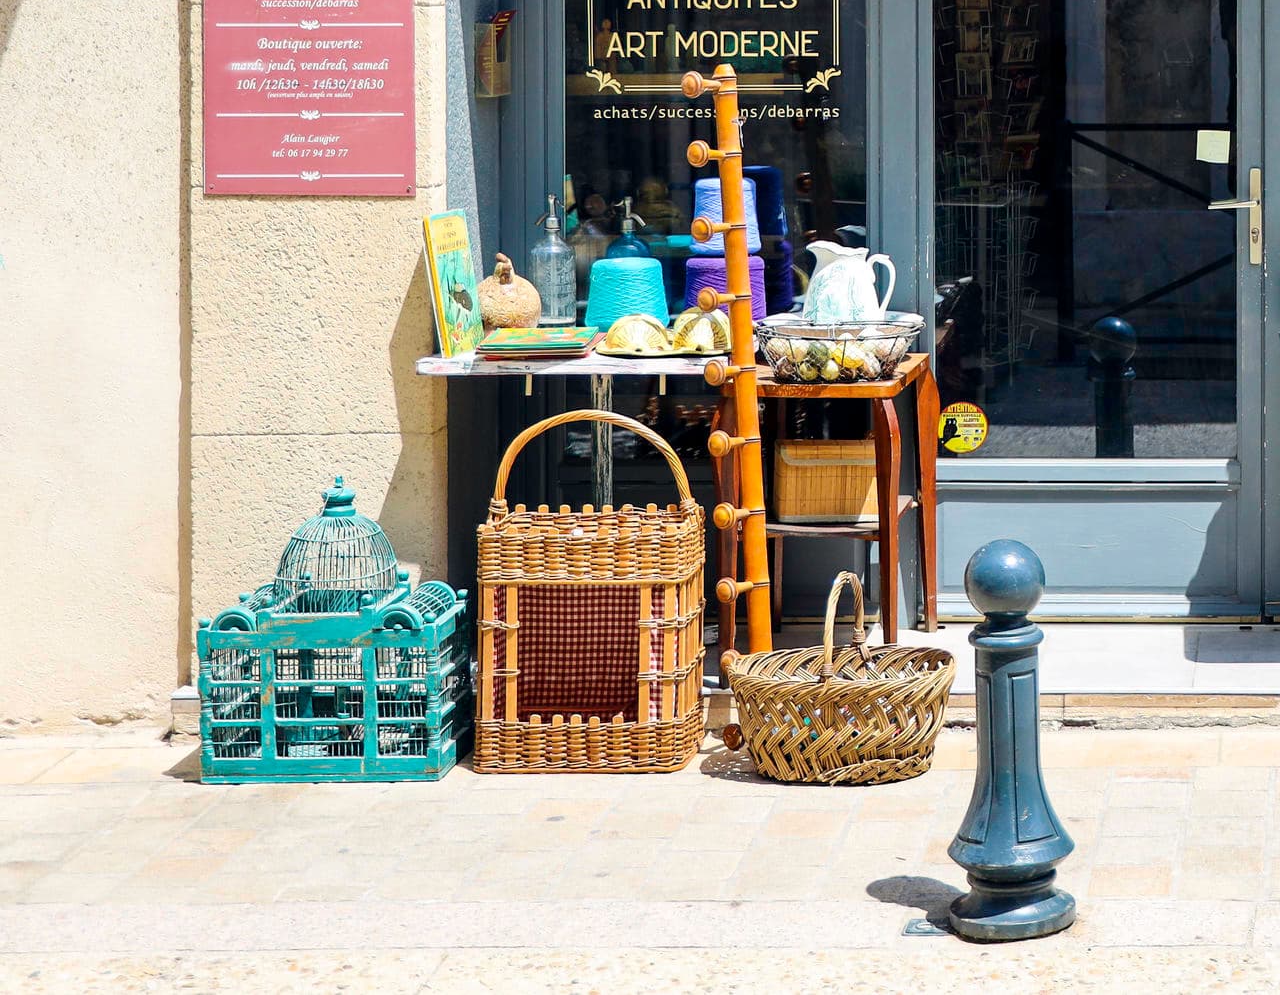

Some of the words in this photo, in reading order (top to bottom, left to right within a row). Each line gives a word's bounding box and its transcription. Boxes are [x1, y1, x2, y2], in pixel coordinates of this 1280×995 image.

[257, 37, 312, 52] Boutique
[315, 40, 363, 50] ouverte:
[606, 31, 664, 58] ART
[675, 30, 820, 58] MODERNE
[231, 59, 264, 72] mardi,
[265, 59, 297, 74] jeudi,
[301, 59, 349, 72] vendredi,
[352, 59, 389, 71] samedi
[236, 78, 256, 90] 10h
[593, 105, 840, 120] achats/succesns/debarras
[281, 134, 306, 144] Alain
[307, 134, 340, 145] Laugier
[287, 149, 299, 158] 06
[301, 149, 311, 158] 17
[312, 149, 323, 158] 94
[325, 149, 336, 158] 29
[338, 149, 349, 158] 77
